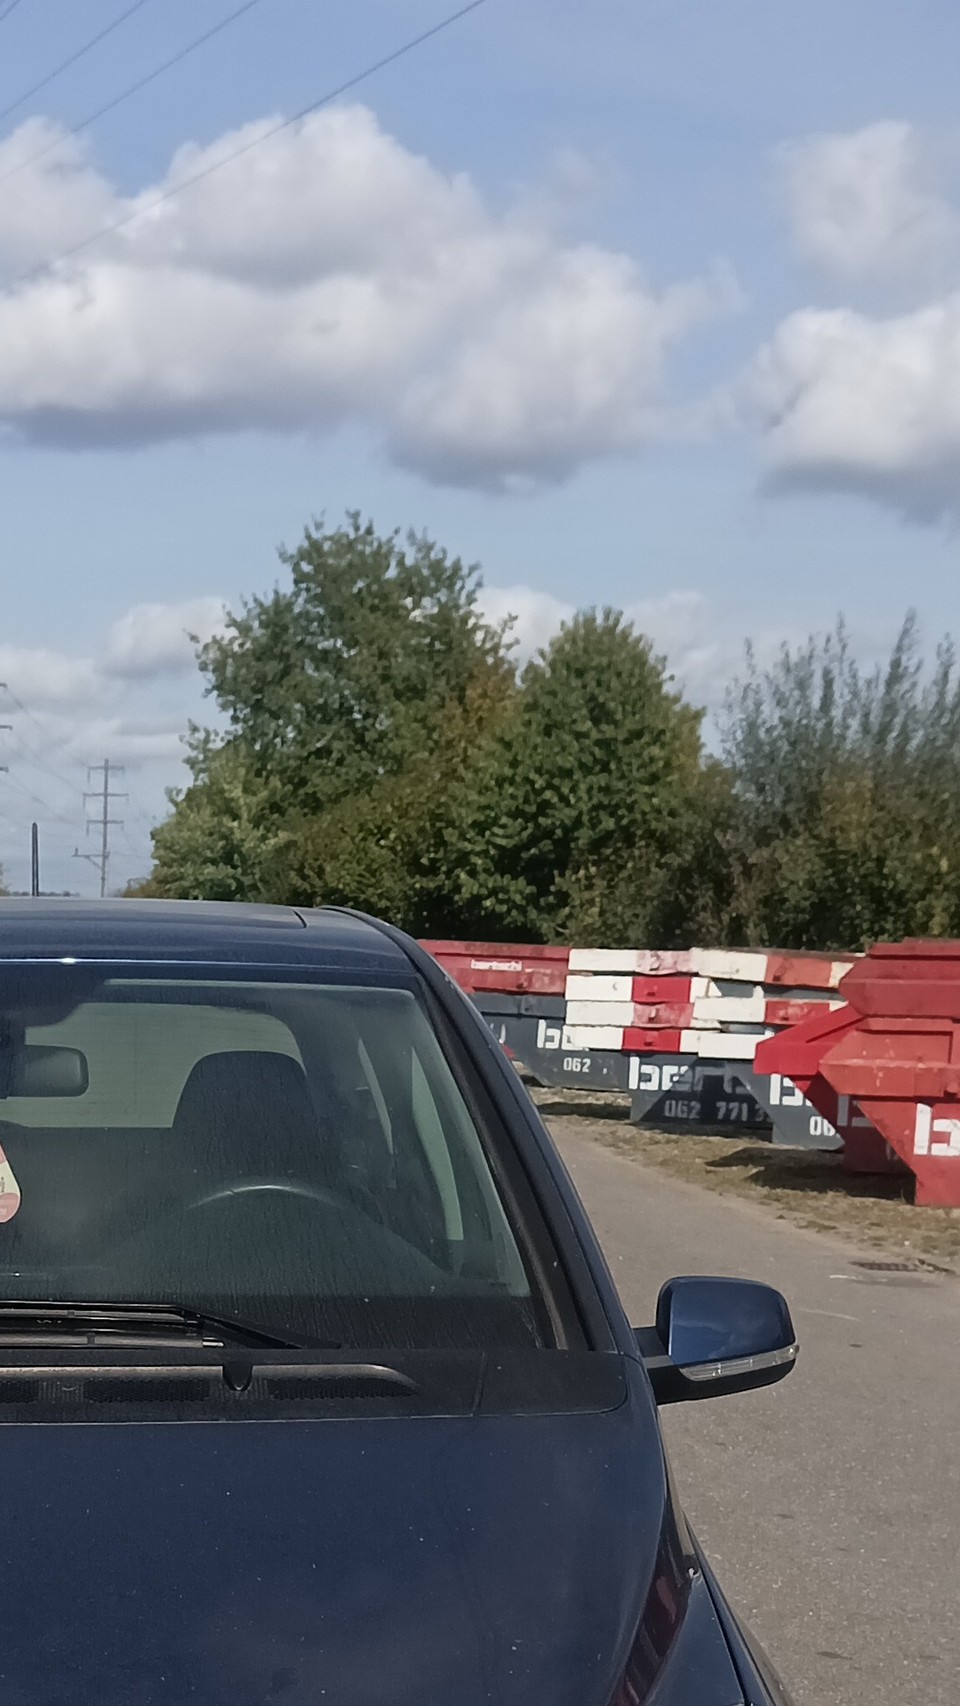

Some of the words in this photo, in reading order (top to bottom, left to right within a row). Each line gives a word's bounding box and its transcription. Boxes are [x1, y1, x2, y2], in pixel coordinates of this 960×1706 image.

[563, 1058, 591, 1073] 062
[664, 1100, 702, 1119] 062
[715, 1101, 748, 1121] 771
